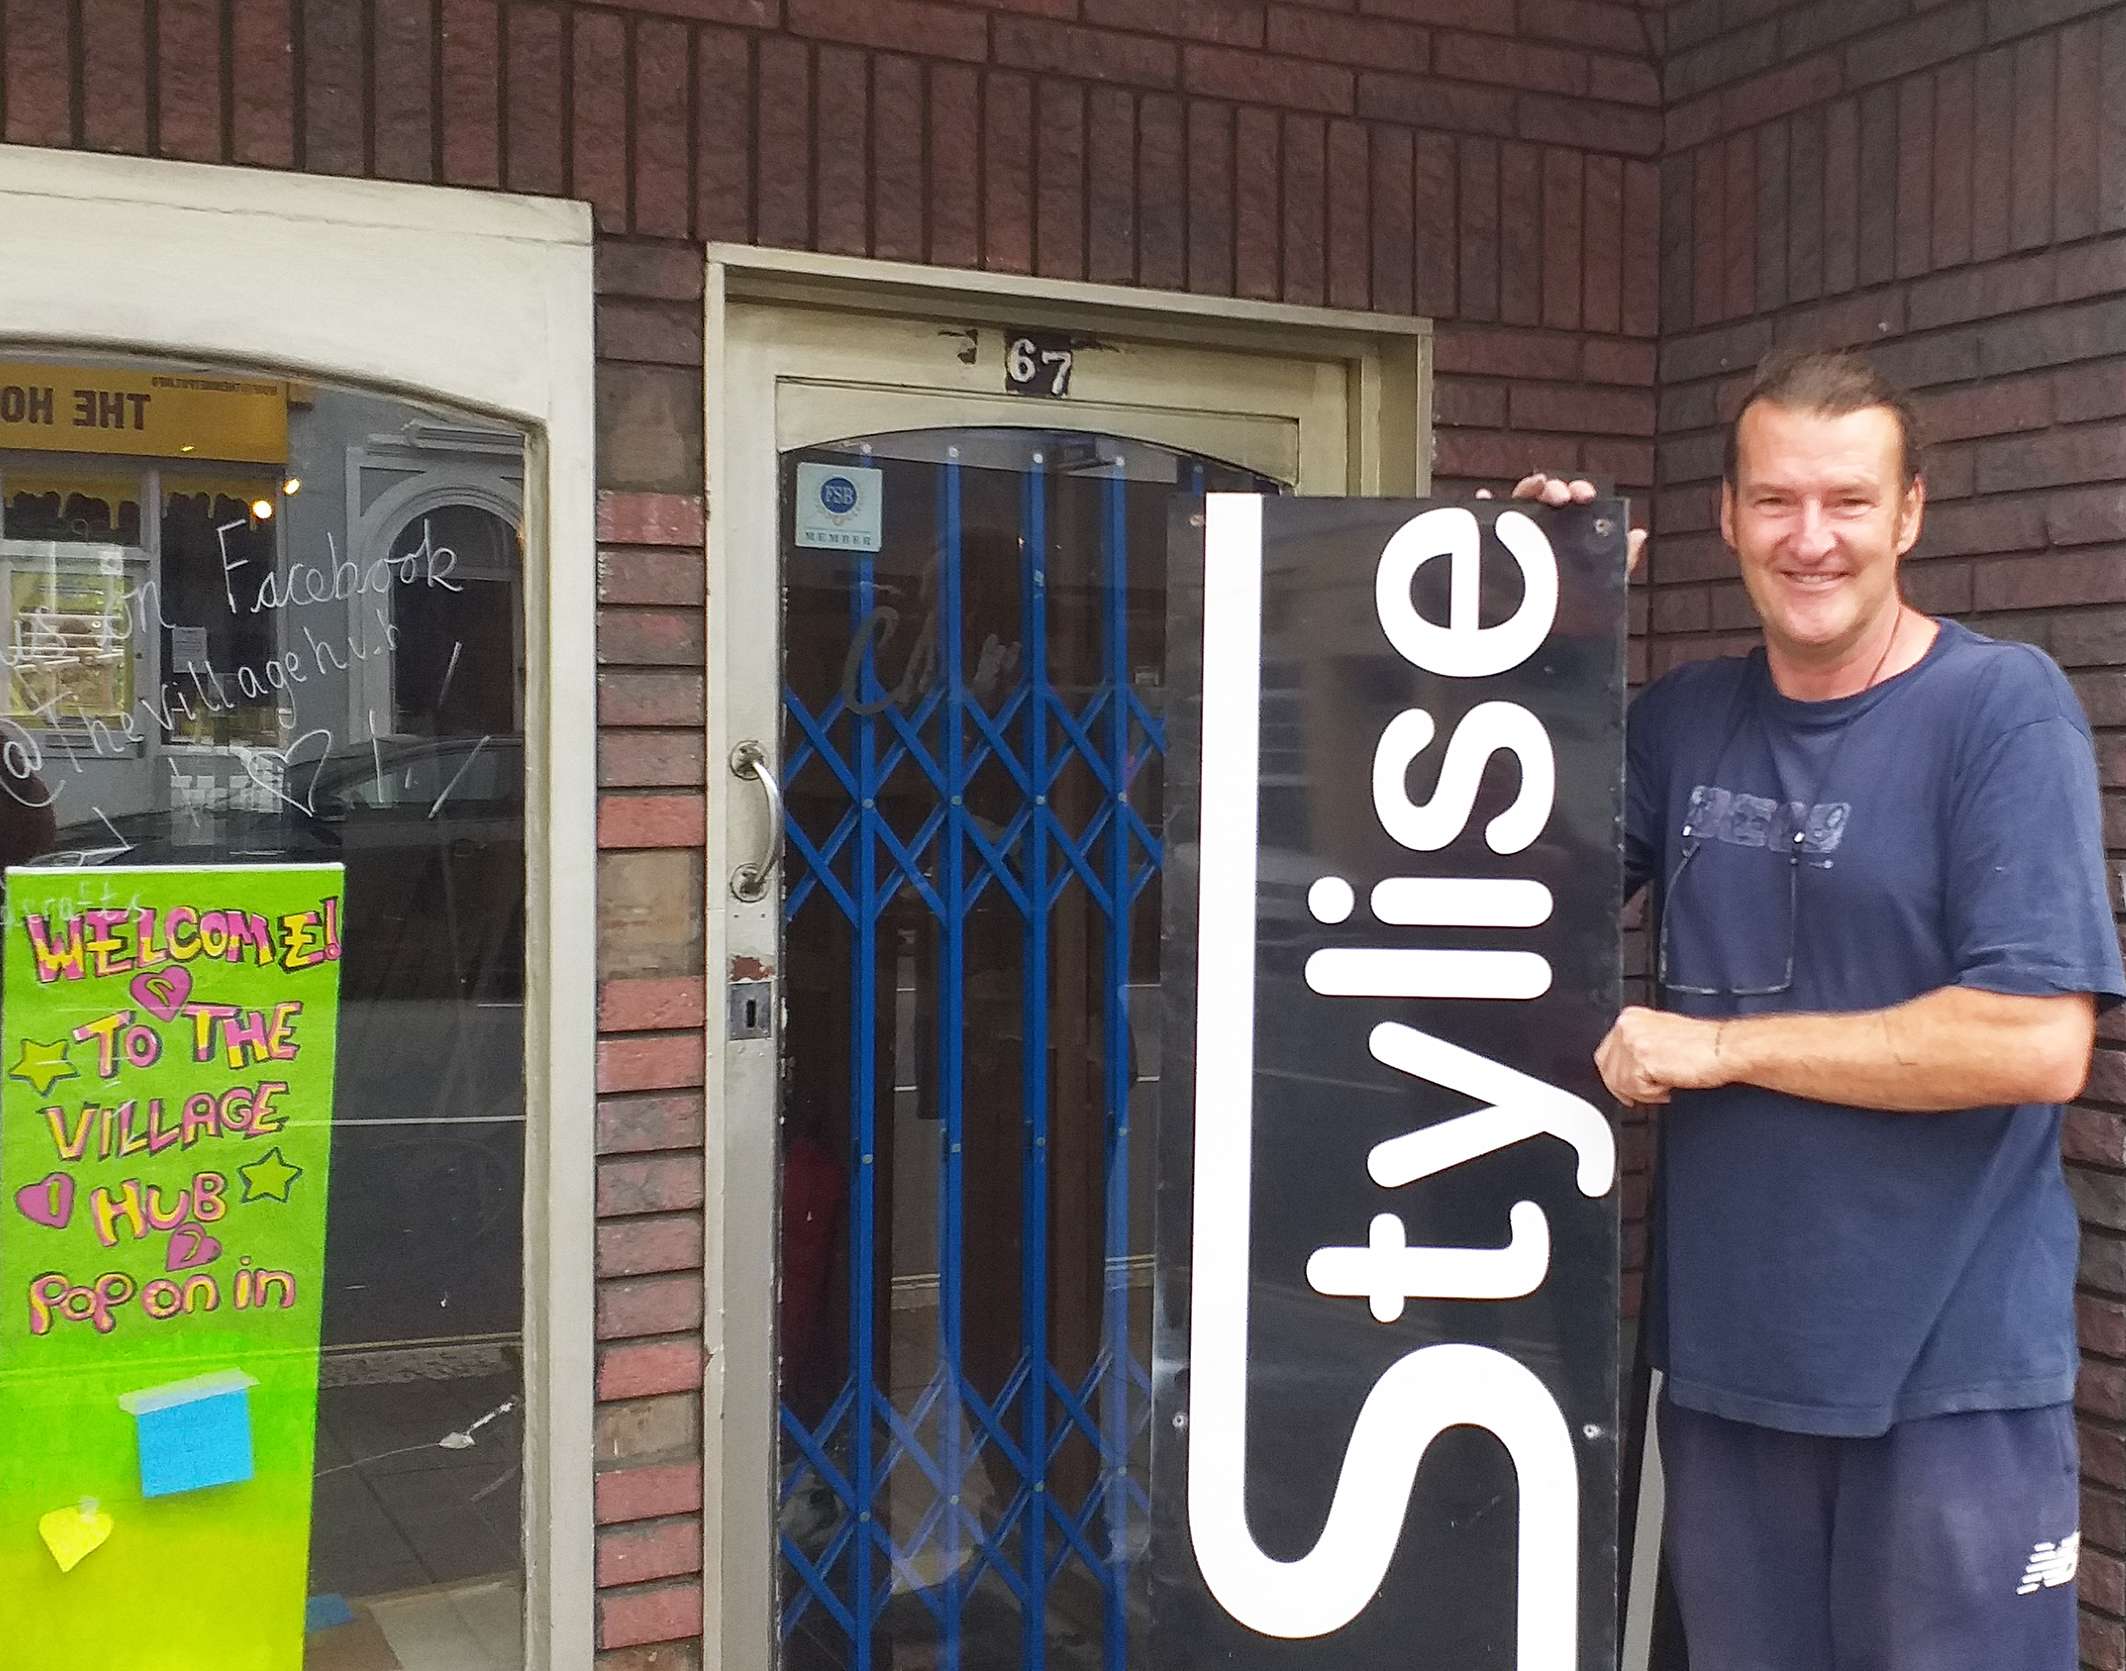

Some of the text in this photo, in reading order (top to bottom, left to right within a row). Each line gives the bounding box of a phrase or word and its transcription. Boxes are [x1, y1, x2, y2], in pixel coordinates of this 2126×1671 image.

[1006, 338, 1073, 395] 67
[824, 485, 855, 505] FSB
[216, 518, 464, 613] Facebook
[805, 531, 872, 546] MEMBER
[22, 896, 344, 984] WELCOME!
[72, 1000, 304, 1079] TO THE
[1187, 492, 1617, 1671] Stylise
[37, 1080, 289, 1162] VILLAGE
[89, 1171, 230, 1248] HUB
[233, 1256, 296, 1311] in
